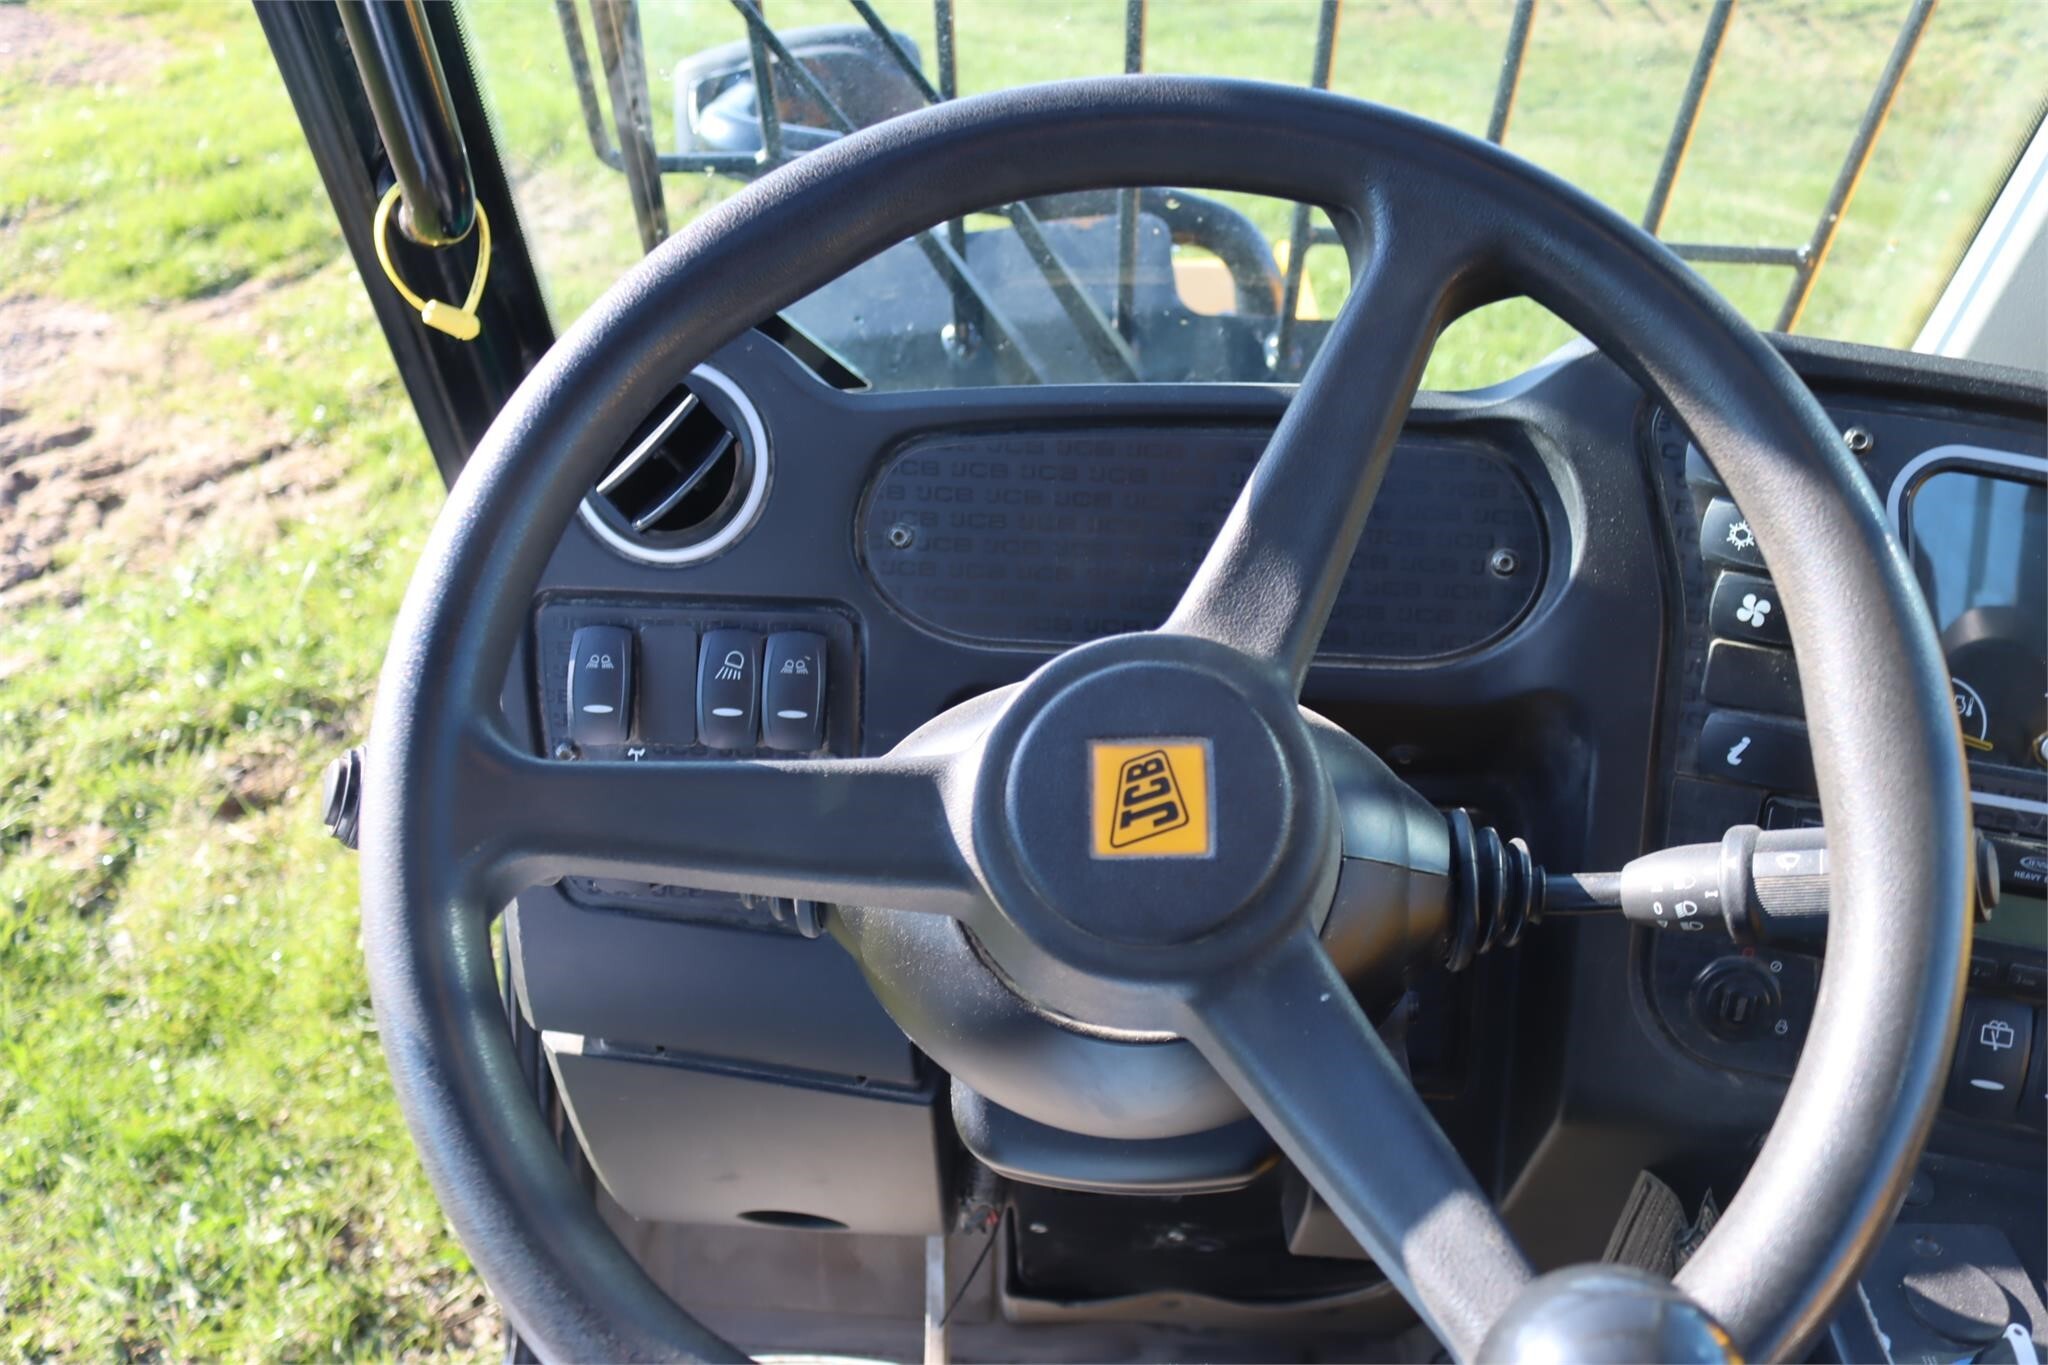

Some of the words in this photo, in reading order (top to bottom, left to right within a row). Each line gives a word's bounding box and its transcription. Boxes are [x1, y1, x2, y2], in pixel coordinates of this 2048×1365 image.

[951, 462, 1009, 480] JCB
[1020, 464, 1078, 483] JCB
[1088, 467, 1148, 486] JCB
[916, 486, 974, 504] JCB
[985, 489, 1044, 507] JCB
[1054, 491, 1113, 510] JCB
[950, 512, 1007, 531] JCB
[881, 558, 937, 578] JCB
[1119, 756, 1180, 830] JCB
[2014, 870, 2041, 882] HEAVY
